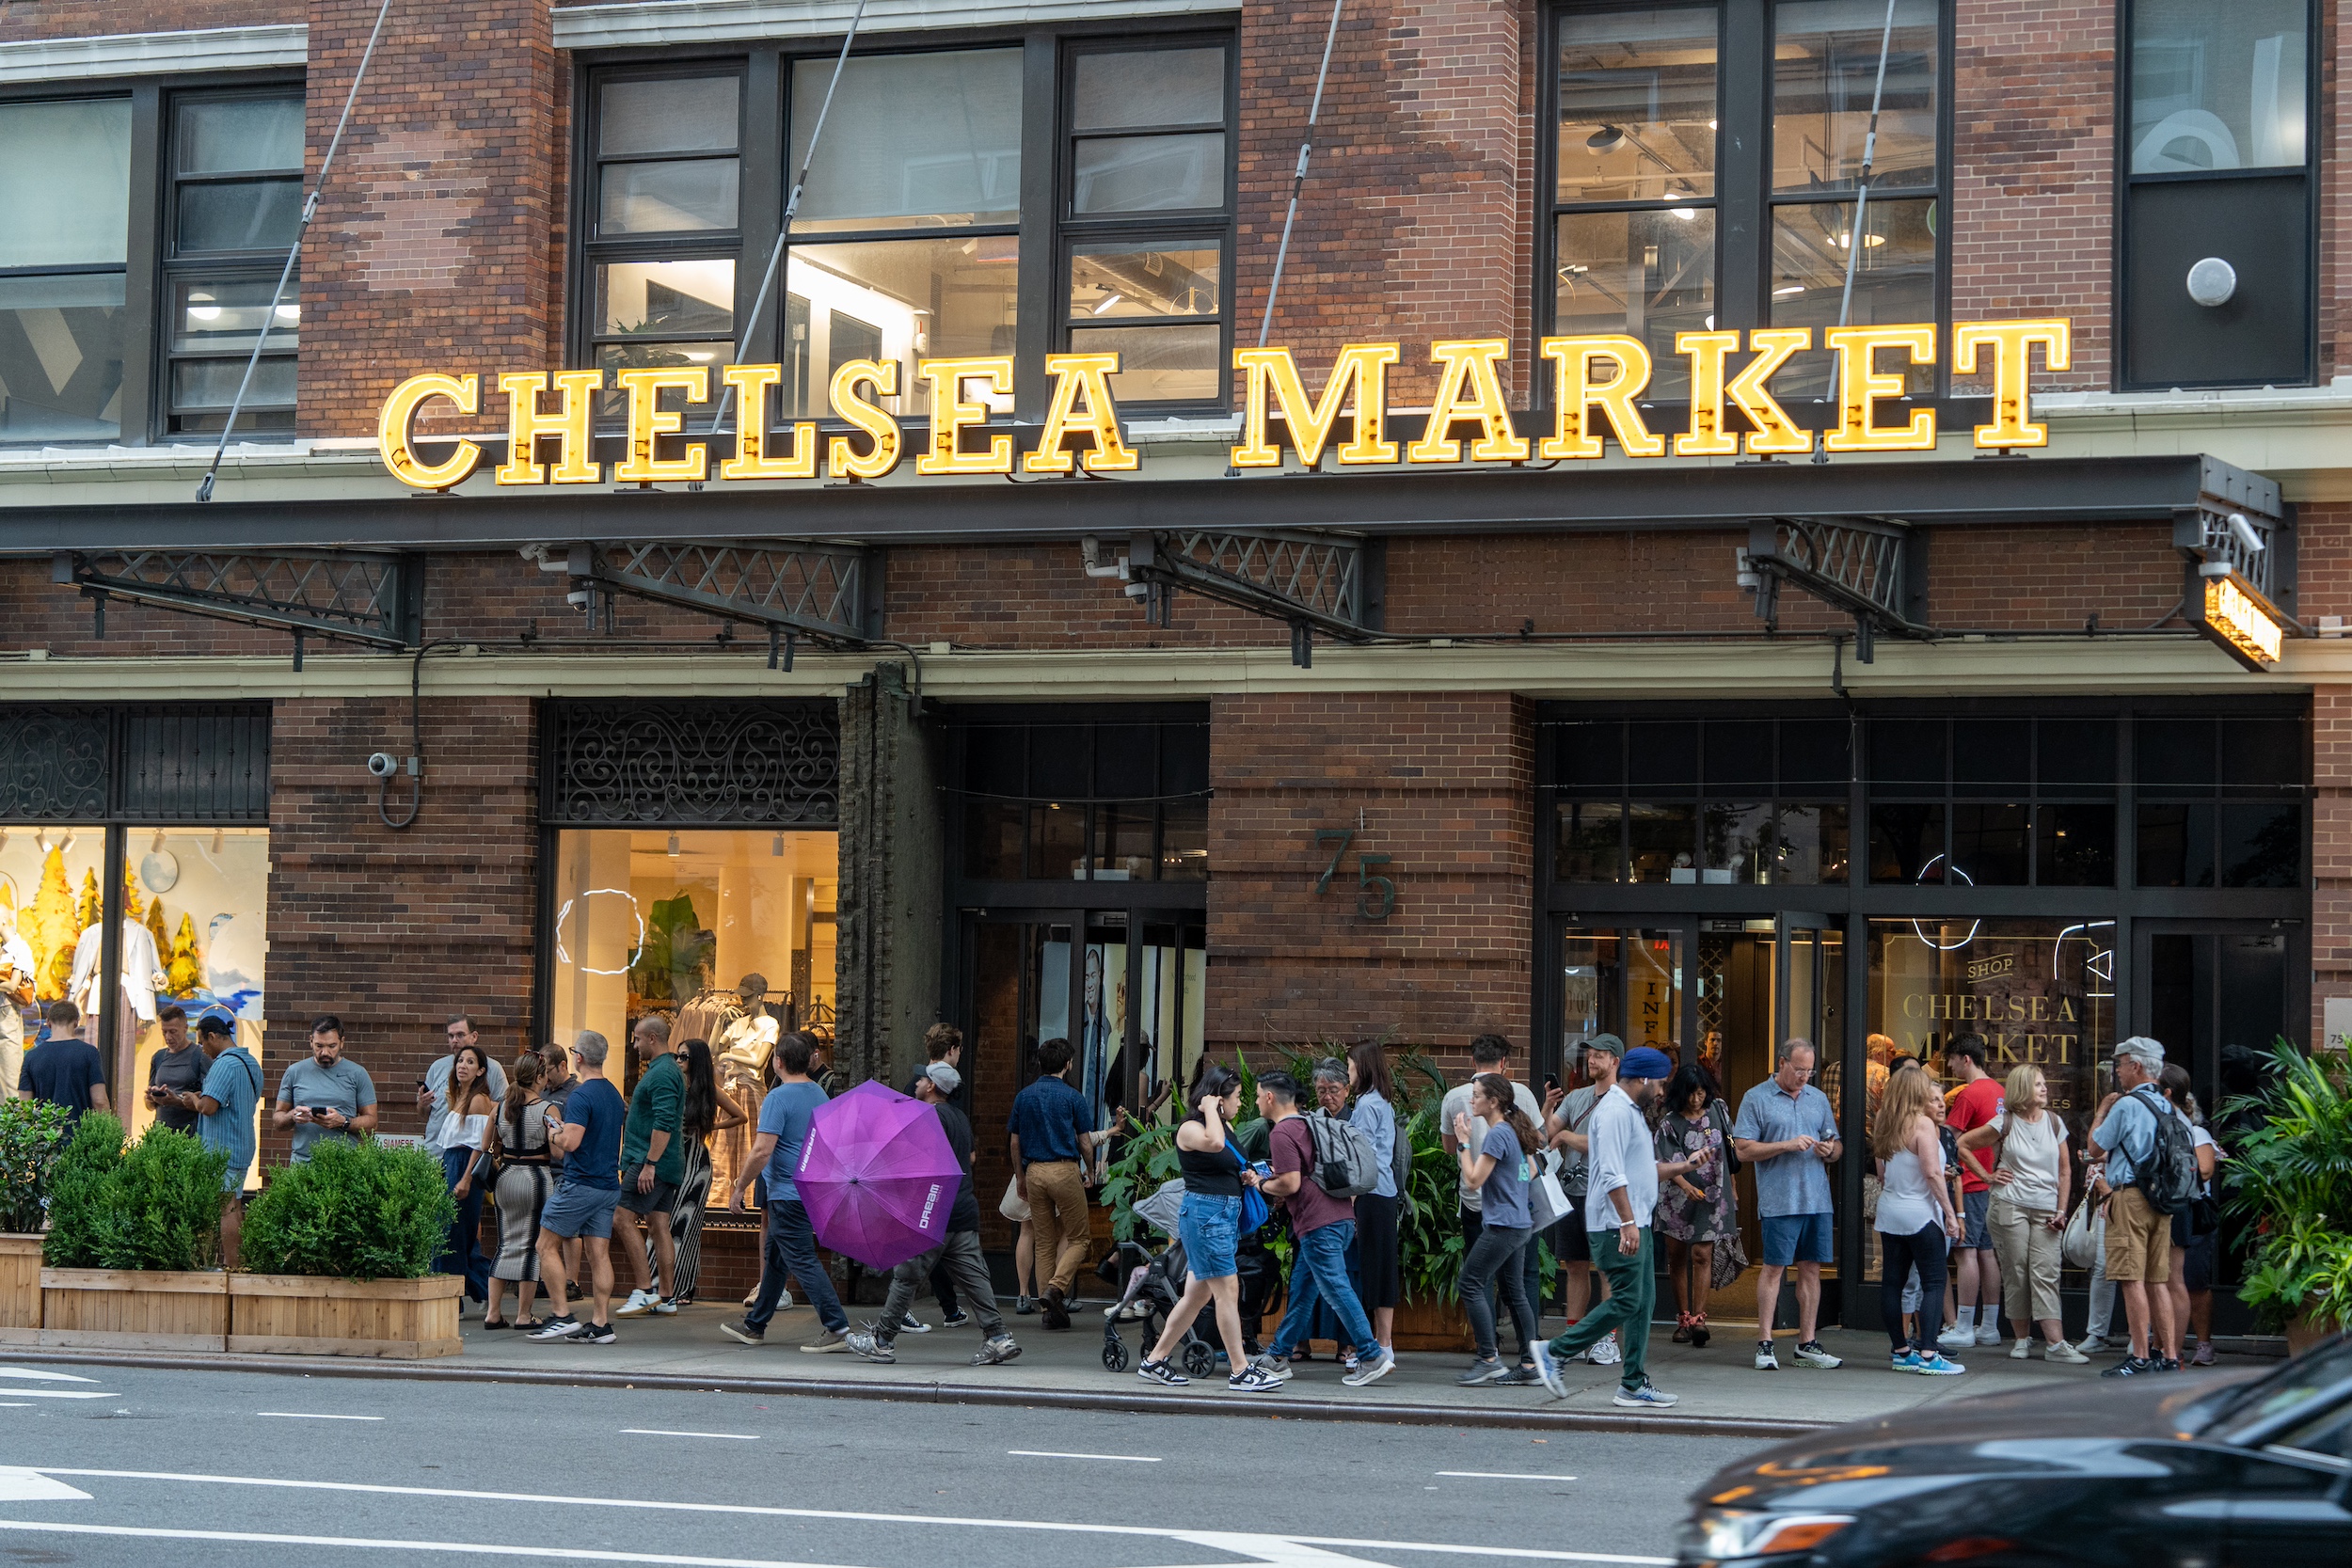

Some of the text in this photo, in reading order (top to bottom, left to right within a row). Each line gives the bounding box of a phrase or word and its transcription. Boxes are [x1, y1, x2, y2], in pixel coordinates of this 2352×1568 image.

[377, 317, 2073, 490] CHELSEA MARKET
[1314, 828, 1394, 919] 75
[1967, 958, 2013, 978] SHOP
[1902, 993, 2077, 1022] CHELSEA
[2330, 1034, 2344, 1044] 75
